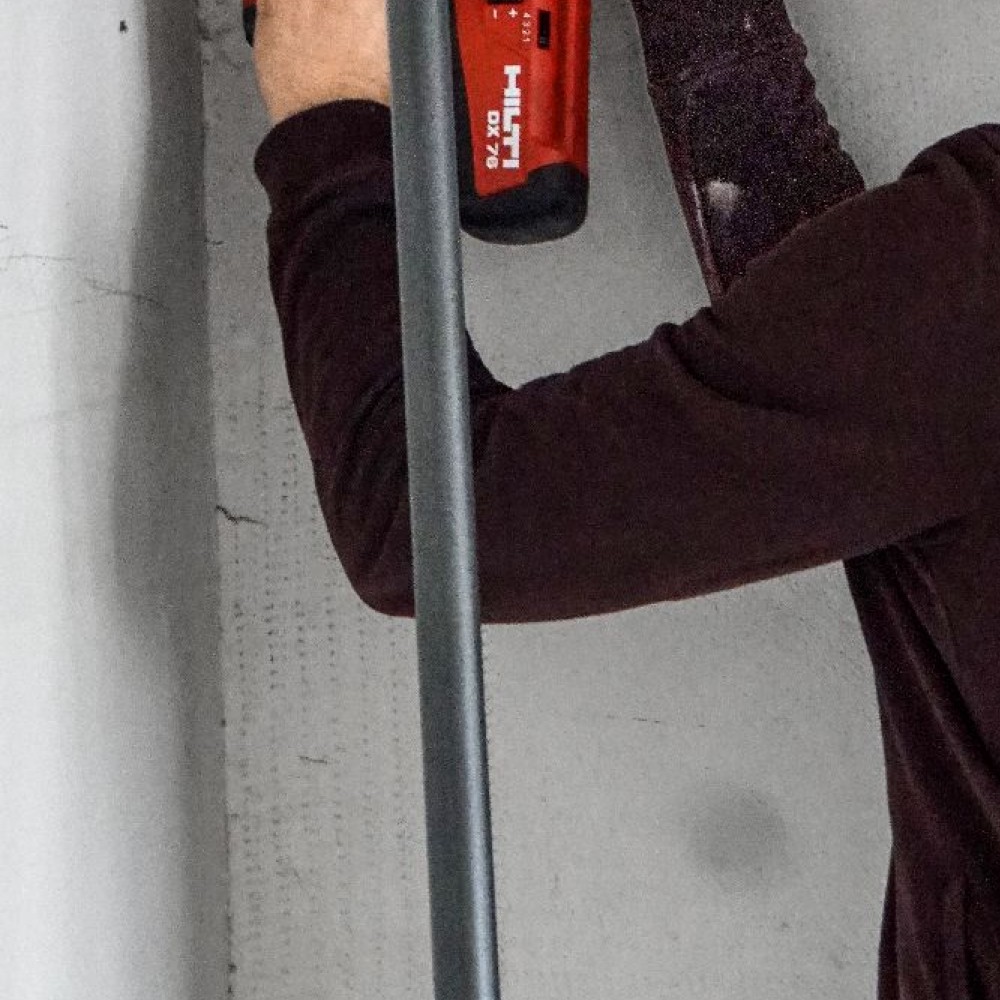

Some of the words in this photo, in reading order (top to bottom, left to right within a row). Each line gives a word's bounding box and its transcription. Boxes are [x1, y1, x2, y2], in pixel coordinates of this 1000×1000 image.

[487, 109, 500, 138] DX
[503, 64, 521, 168] HILTI
[485, 141, 499, 169] 76
